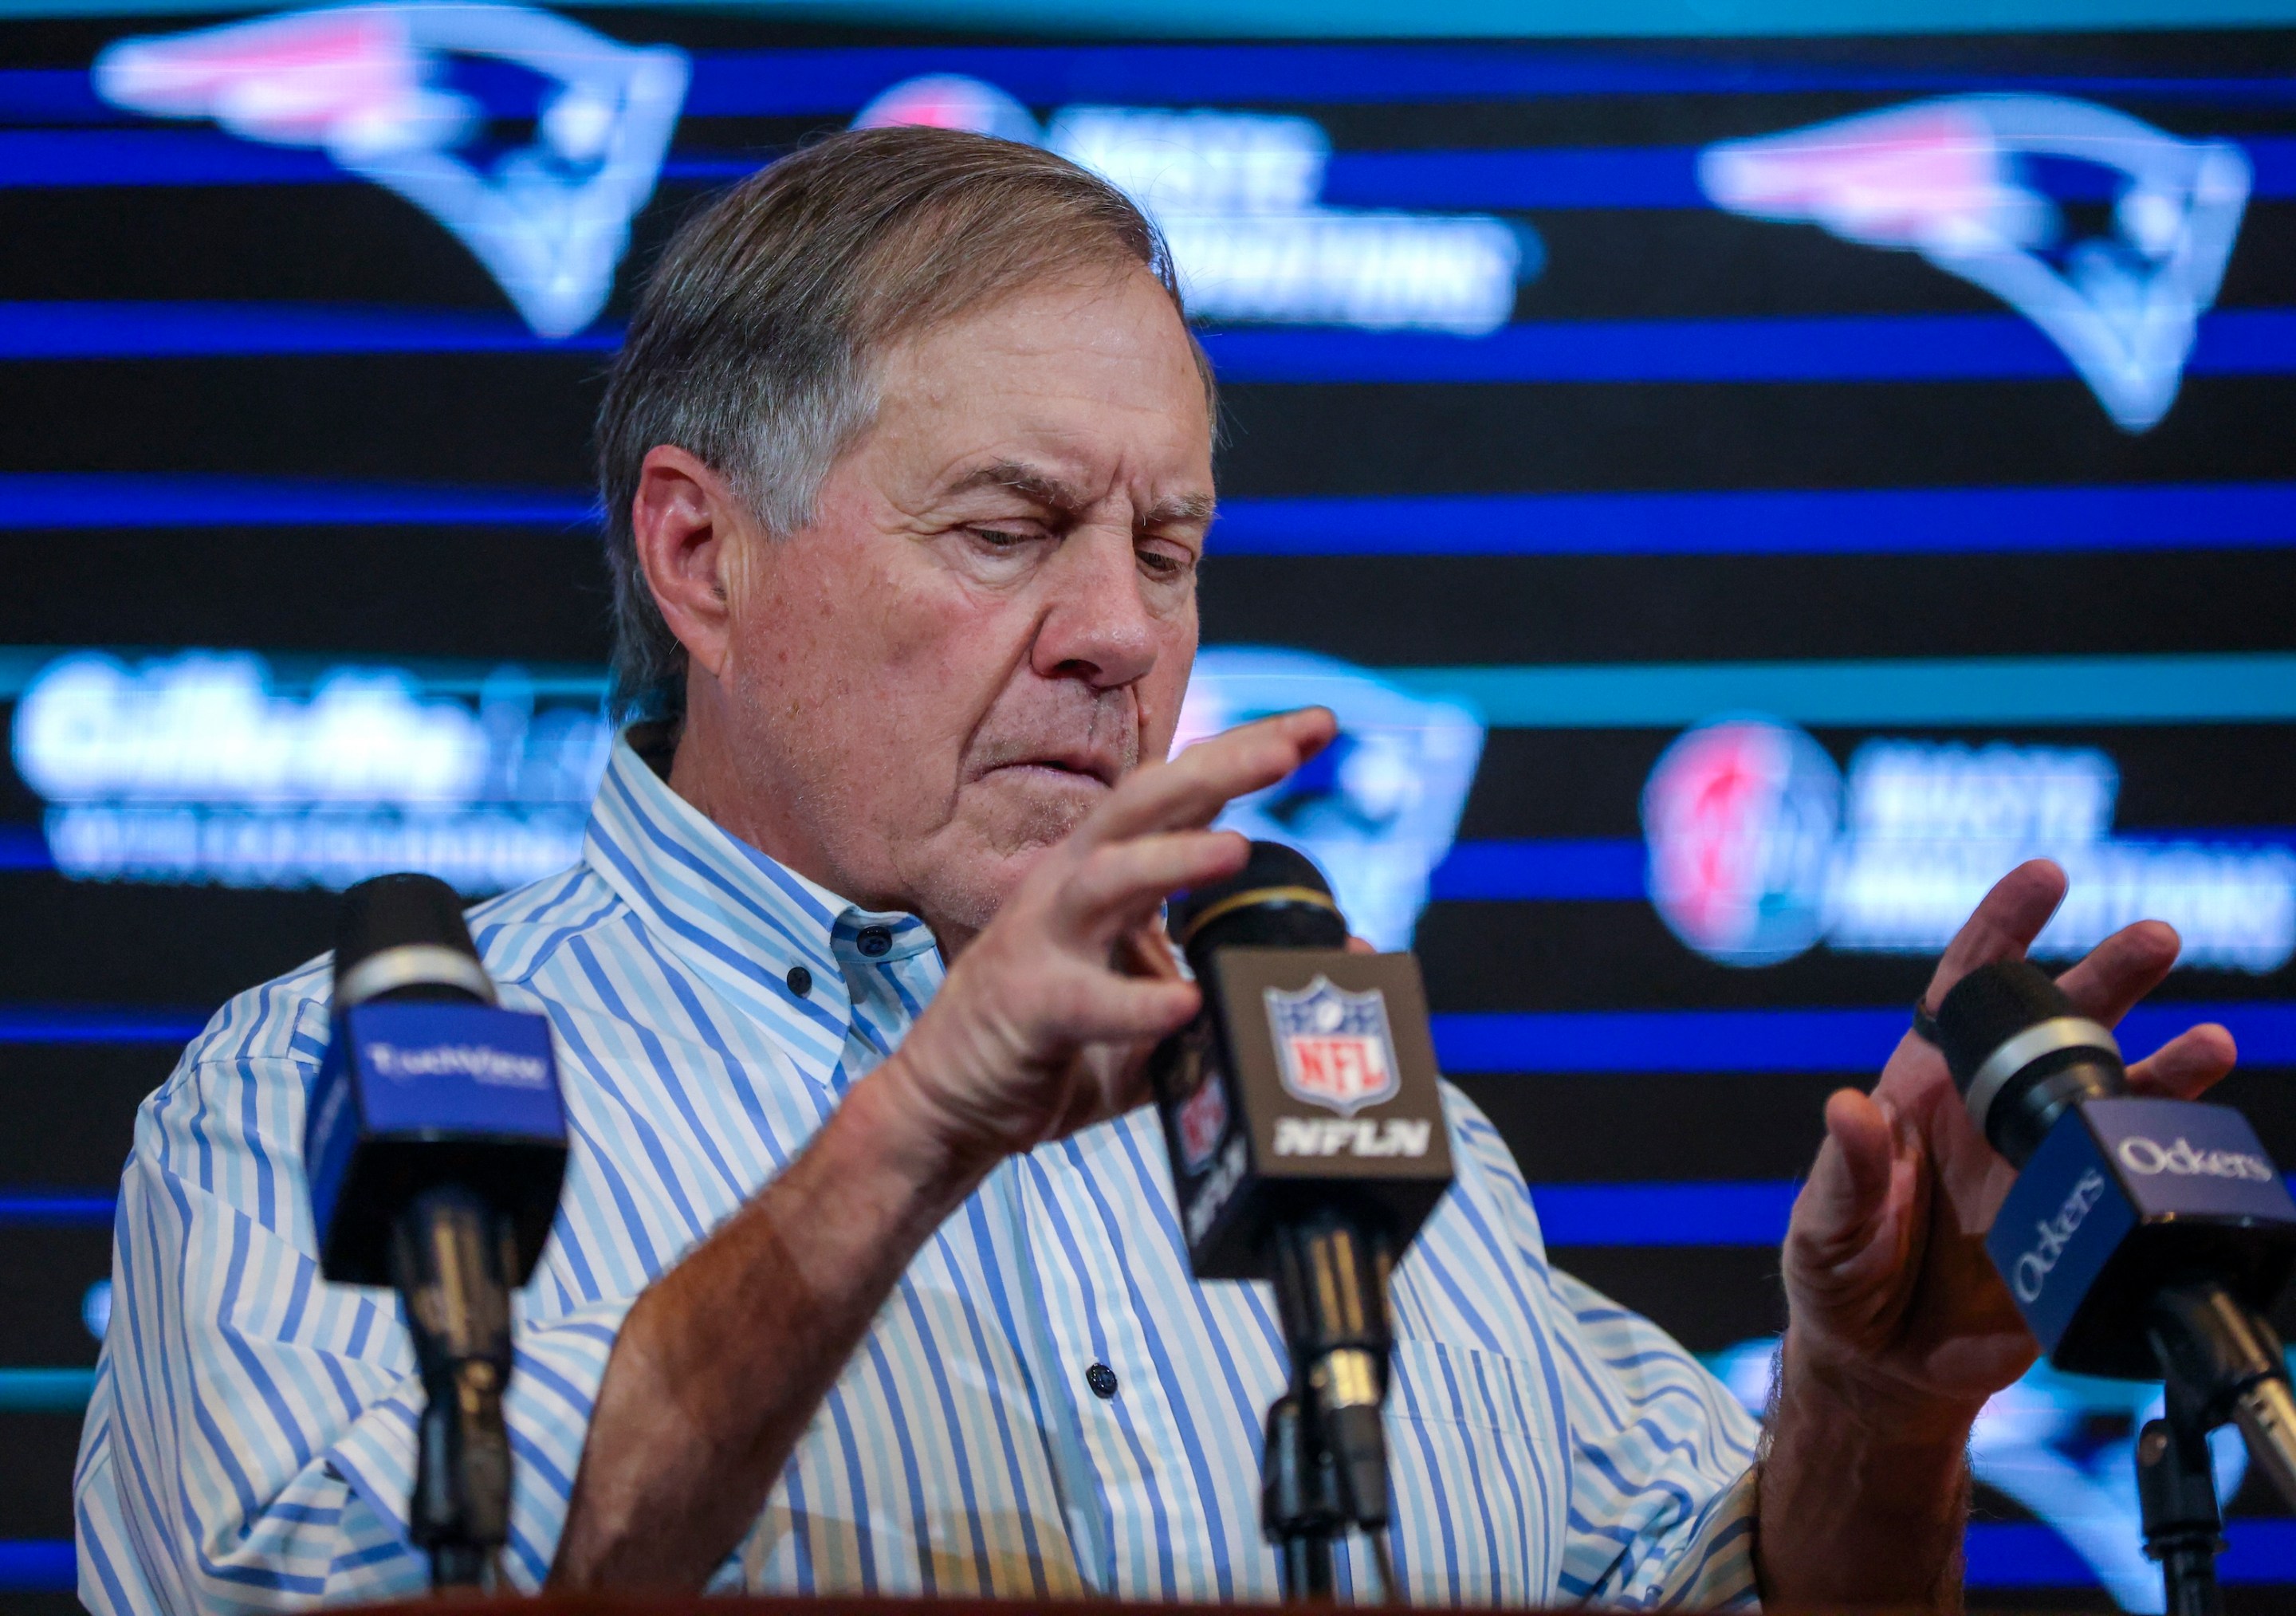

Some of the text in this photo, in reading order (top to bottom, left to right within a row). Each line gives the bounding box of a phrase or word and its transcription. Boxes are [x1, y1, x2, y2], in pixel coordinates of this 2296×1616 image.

[1292, 1036, 1388, 1099] NFL
[1275, 1116, 1432, 1157] NFLN
[2117, 1136, 2272, 1182] Ockers
[2015, 1169, 2105, 1303] Ockers
